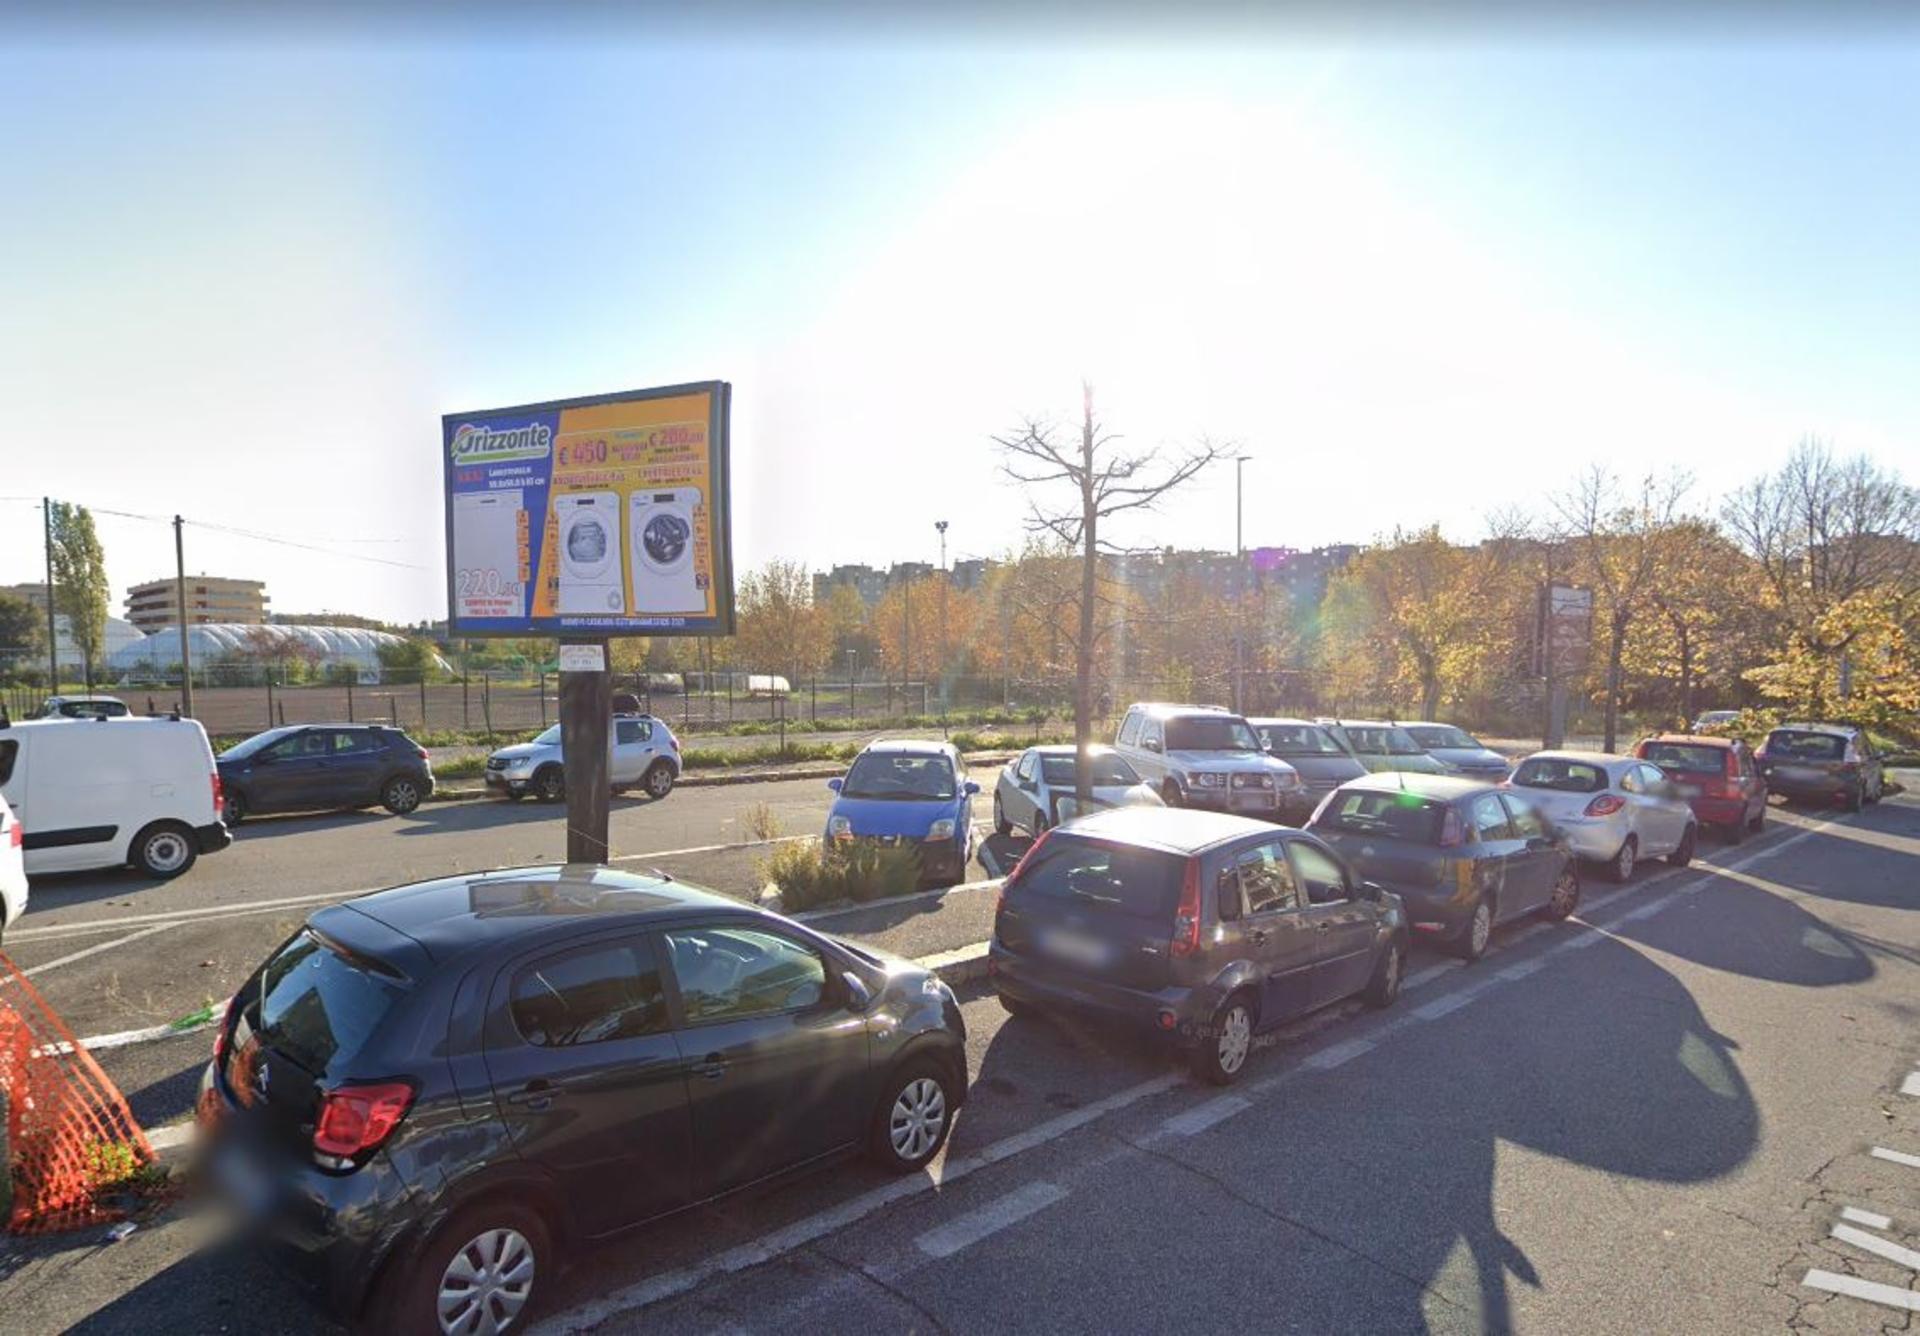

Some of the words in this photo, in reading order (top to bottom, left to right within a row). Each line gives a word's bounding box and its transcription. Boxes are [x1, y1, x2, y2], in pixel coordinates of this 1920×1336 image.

[452, 423, 549, 455] Orizzonte
[559, 447, 568, 466] €
[573, 439, 607, 465] 450
